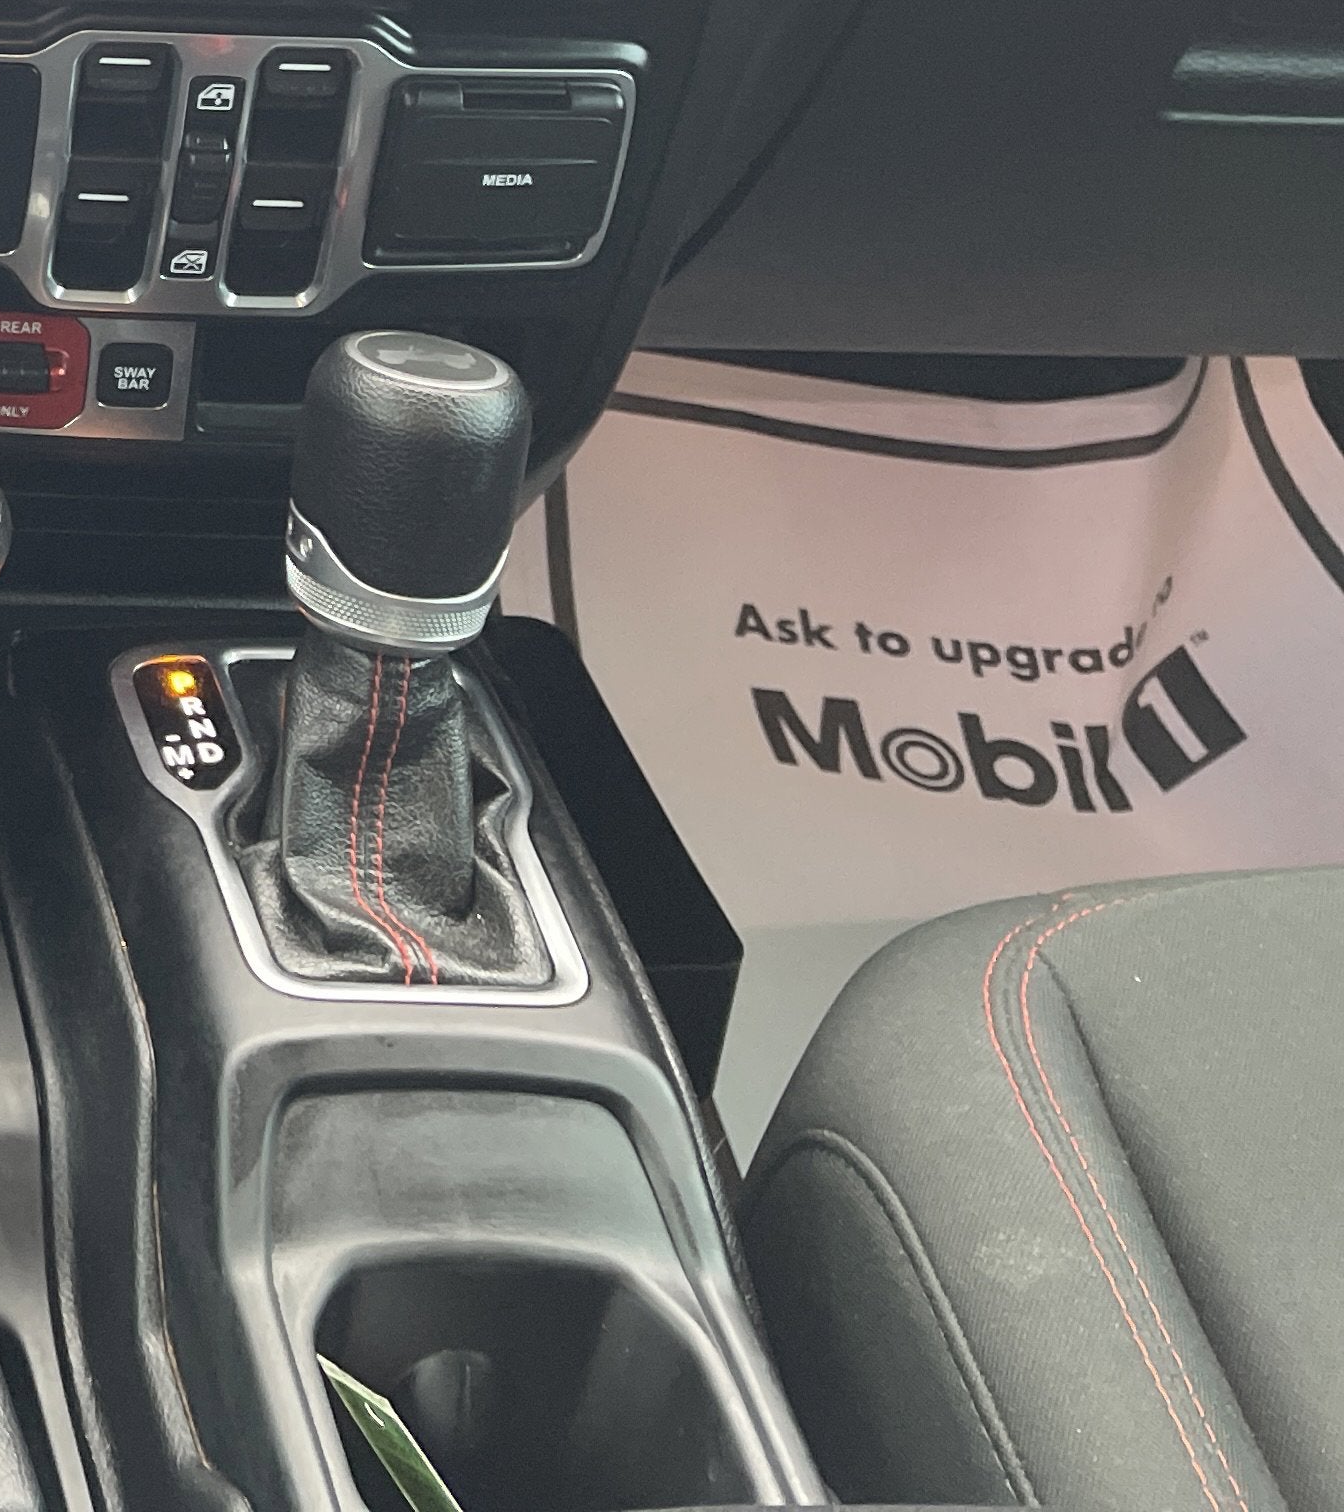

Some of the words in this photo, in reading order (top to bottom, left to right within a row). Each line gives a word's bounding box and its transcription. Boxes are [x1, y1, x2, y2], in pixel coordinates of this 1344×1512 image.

[482, 173, 533, 187] MEDIA
[113, 366, 156, 379] SWAY
[117, 378, 150, 391] BAR
[735, 603, 838, 650] Ask
[855, 621, 911, 657] to
[931, 622, 1146, 682] upgrad
[179, 696, 206, 716] R
[188, 718, 217, 739] N
[162, 745, 195, 766] M
[196, 742, 224, 763] D
[751, 687, 1134, 813] Mobil
